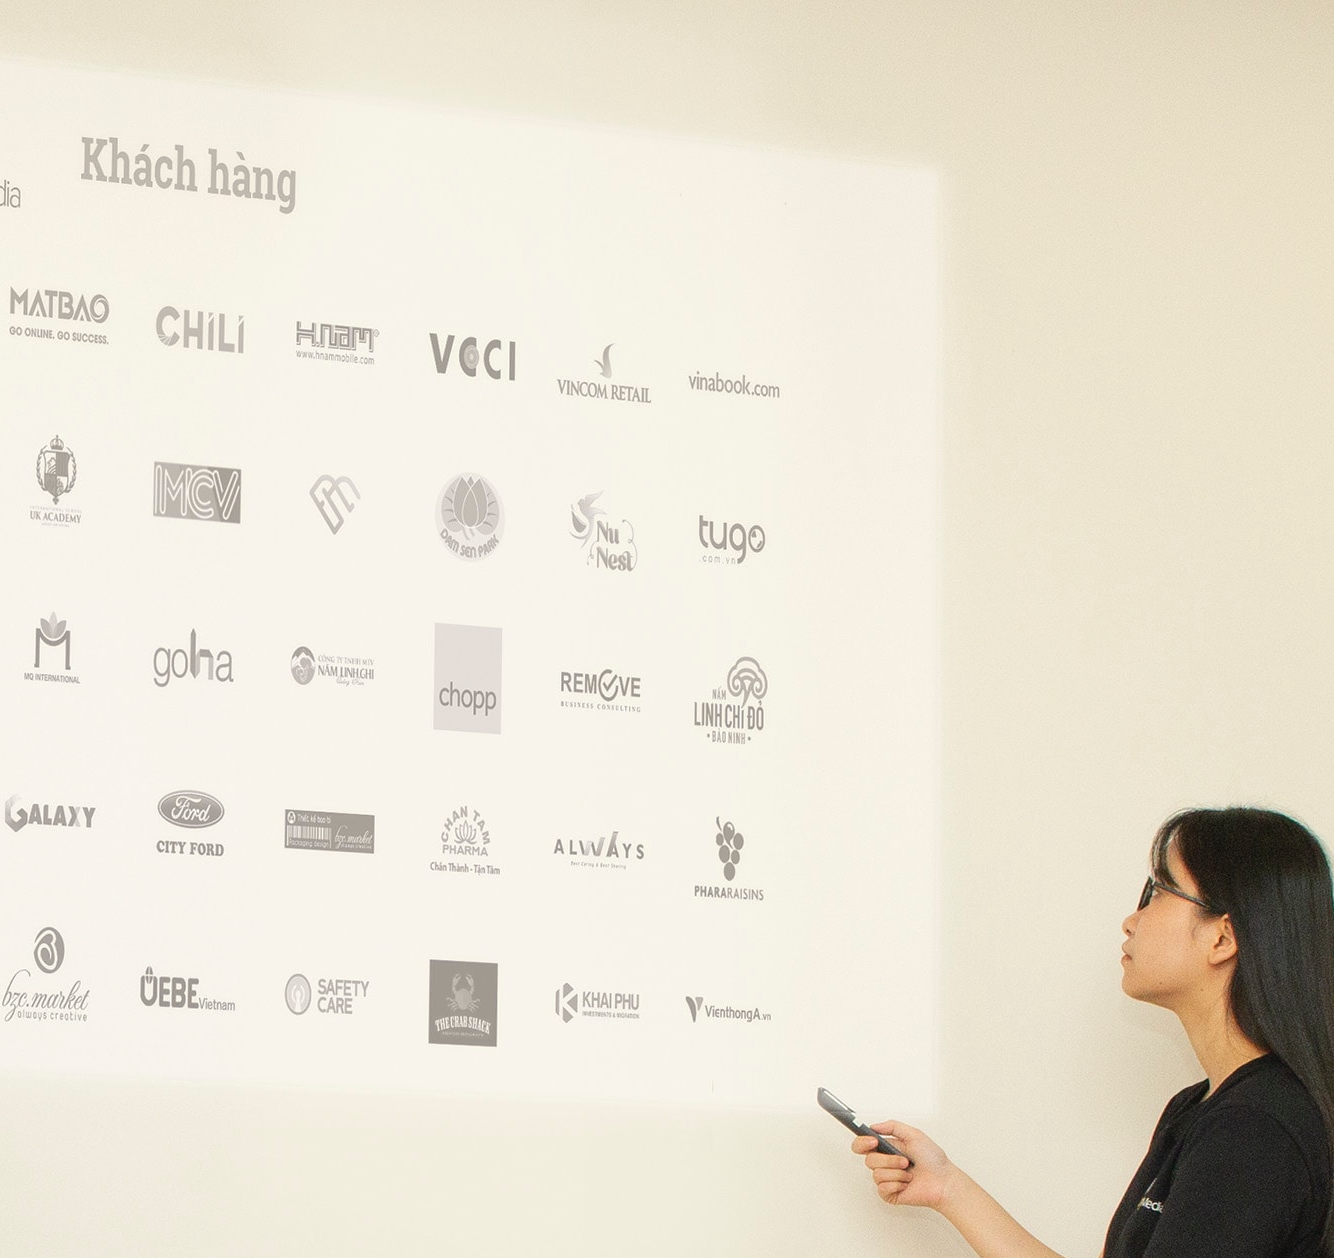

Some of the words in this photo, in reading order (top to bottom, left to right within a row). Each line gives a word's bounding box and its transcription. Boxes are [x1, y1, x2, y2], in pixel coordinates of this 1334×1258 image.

[81, 136, 198, 193] Khách
[208, 148, 297, 215] hàng
[10, 286, 109, 323] MATBAO
[9, 326, 23, 336] GO
[24, 327, 55, 340] ONLINE.
[57, 331, 70, 341] GO
[72, 332, 109, 345] SUCCESS.
[295, 350, 375, 365] www.hnammobile.com
[429, 332, 516, 382] VCCI
[557, 379, 607, 399] VINCOM
[610, 384, 651, 403] RETAIL
[688, 370, 780, 398] vinabook.com
[154, 464, 241, 521] MCV
[30, 510, 42, 521] UK
[43, 511, 82, 524] ACADEMY
[596, 520, 620, 544] Nu
[699, 514, 766, 564] tugo
[596, 546, 634, 572] Nest
[35, 673, 81, 684] INTERNATIONAL
[439, 681, 496, 716] chopp
[694, 701, 723, 728] LINH
[728, 731, 746, 745] NINH
[5, 793, 96, 833] GALAXY
[171, 794, 211, 822] Ford
[156, 840, 186, 854] CITY
[189, 842, 224, 857] FORD
[442, 844, 489, 857] PHARMA
[553, 831, 644, 860] ALWAYS
[694, 885, 764, 901] PHARARAISINS
[317, 978, 369, 997] SAFETY
[317, 996, 353, 1014] CARE
[582, 991, 612, 1009] KHAI
[615, 993, 640, 1010] PHU
[17, 1009, 47, 1021] always
[50, 1010, 88, 1022] creative
[704, 1004, 772, 1023] VienthongA.vn
[435, 1016, 450, 1032] THE
[450, 1015, 468, 1028] CRAB
[468, 1016, 491, 1035] SHACK
